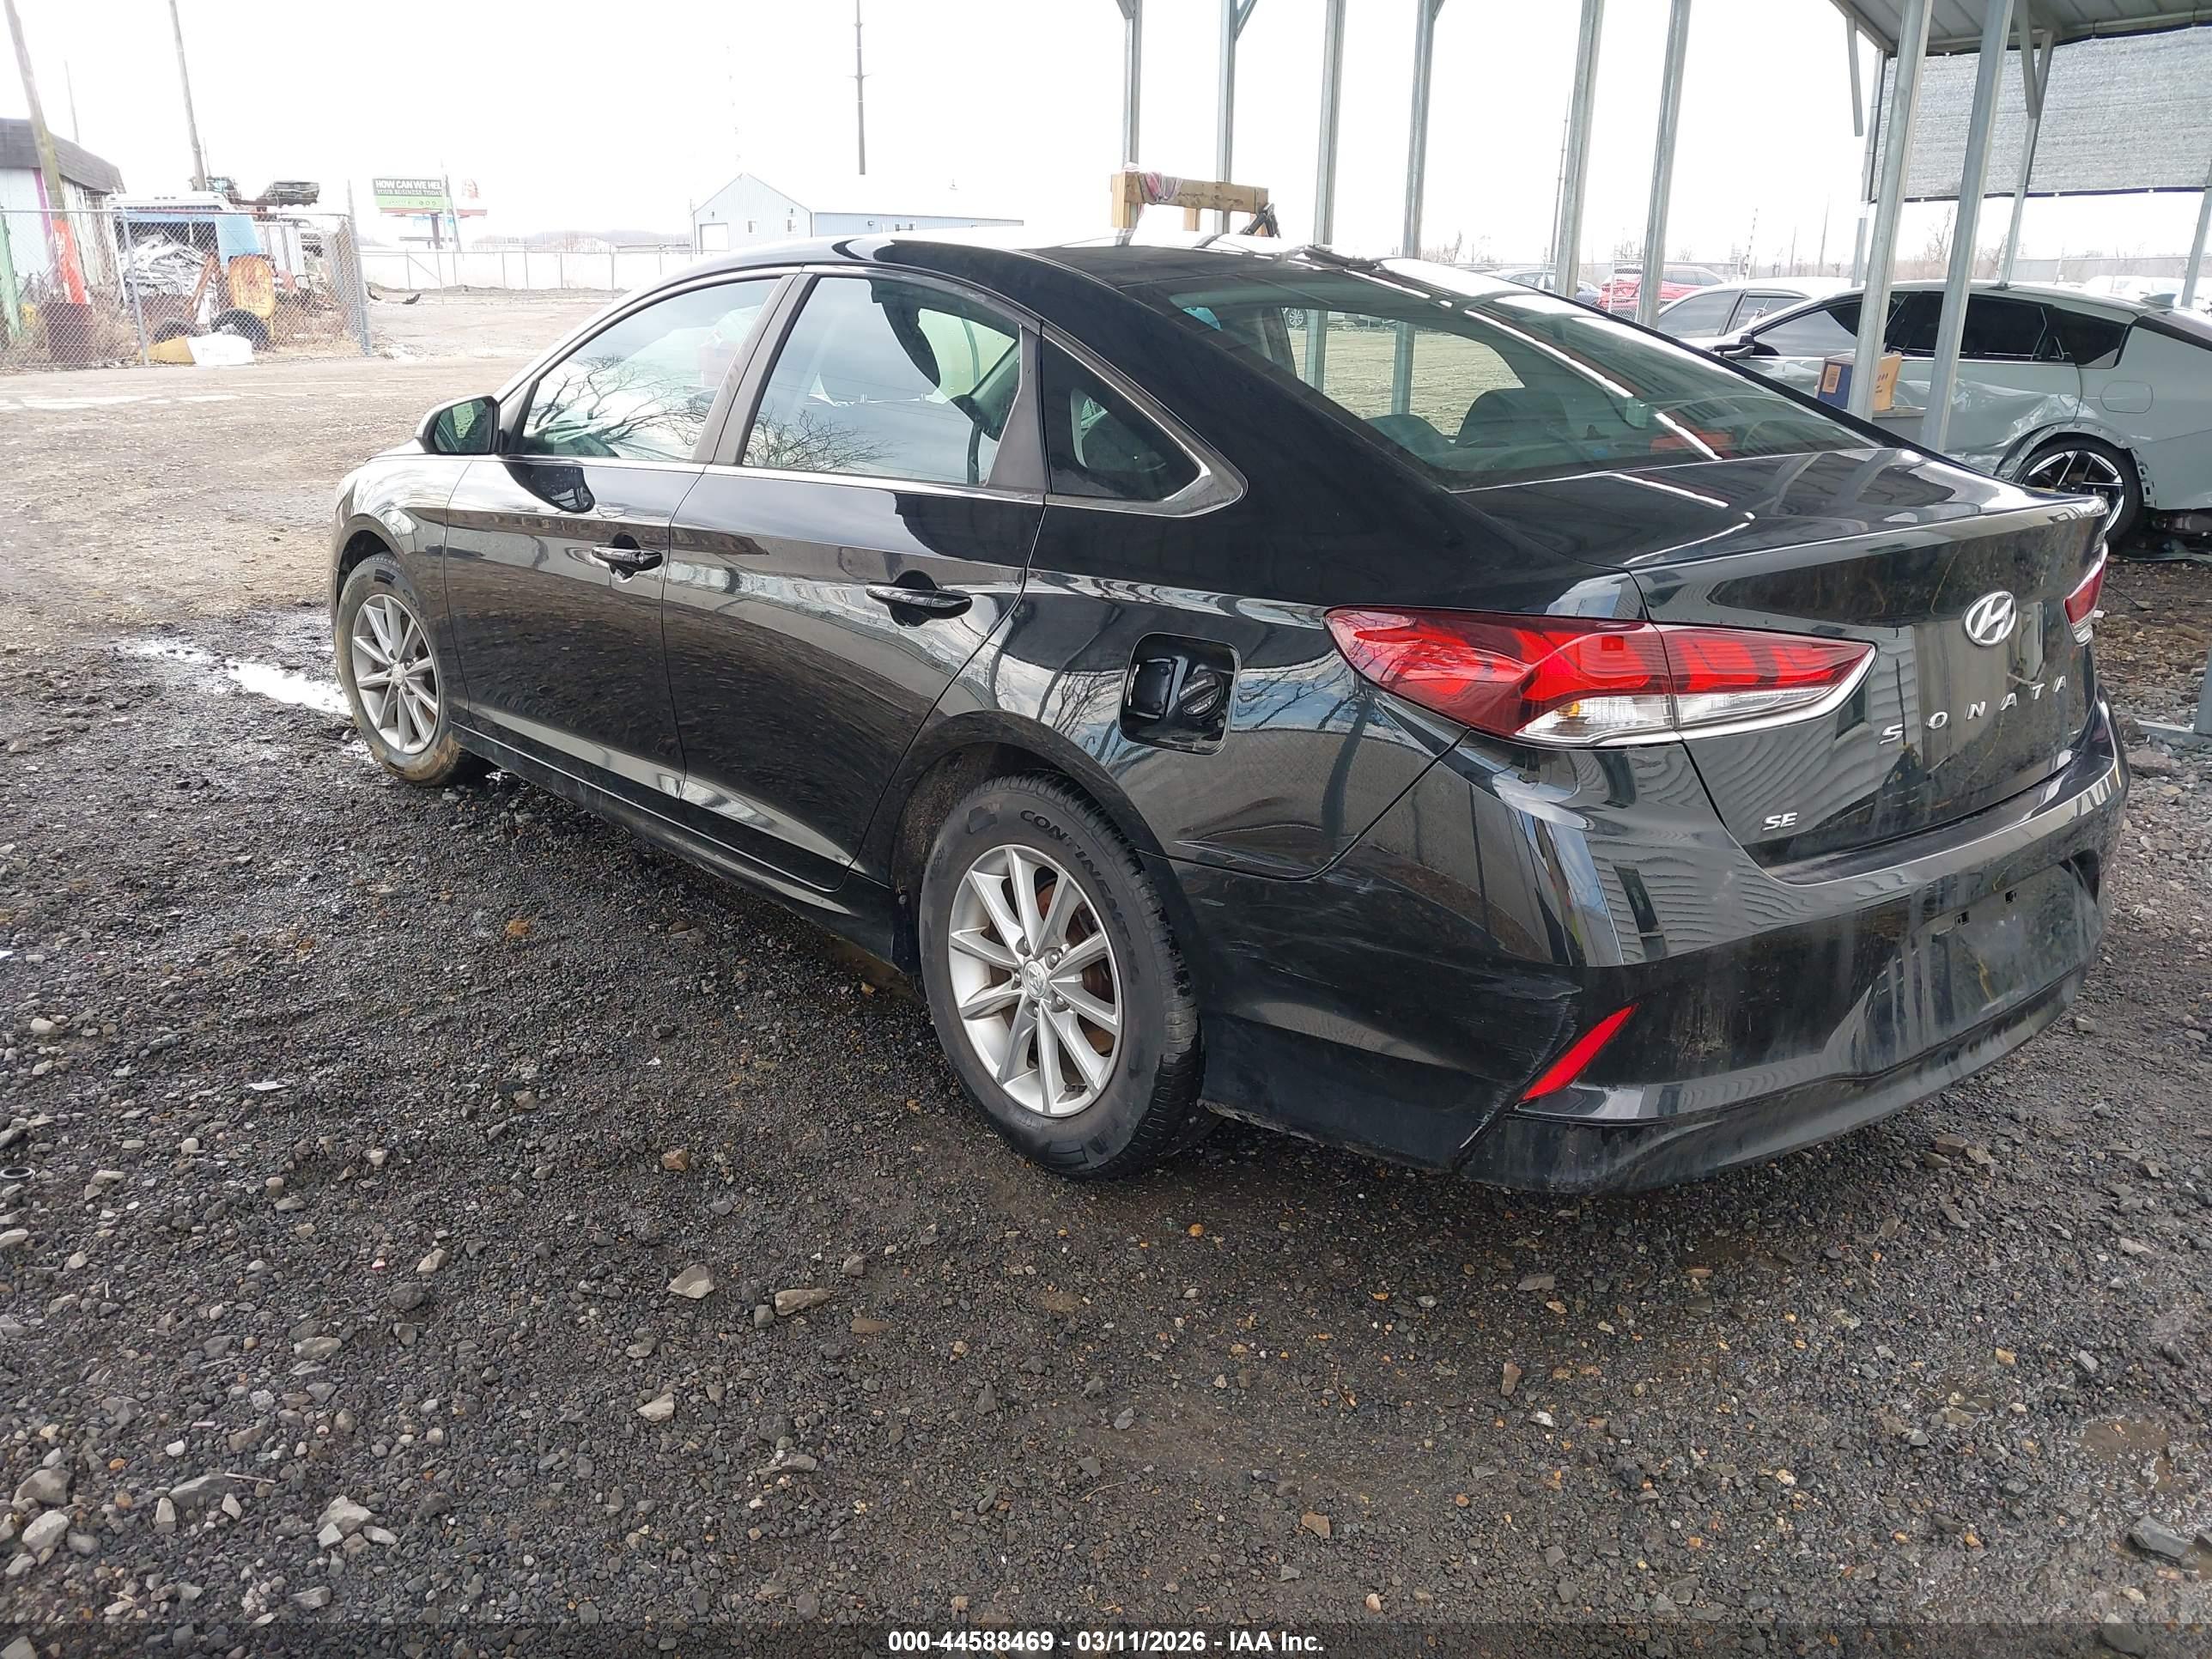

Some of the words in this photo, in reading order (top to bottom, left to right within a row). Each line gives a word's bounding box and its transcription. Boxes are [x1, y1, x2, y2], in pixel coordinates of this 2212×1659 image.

[375, 179, 395, 189] HOW
[396, 180, 414, 189] CAN
[428, 181, 441, 190] HEL
[1879, 675, 2069, 744] SONATA
[1761, 811, 1798, 831] SE
